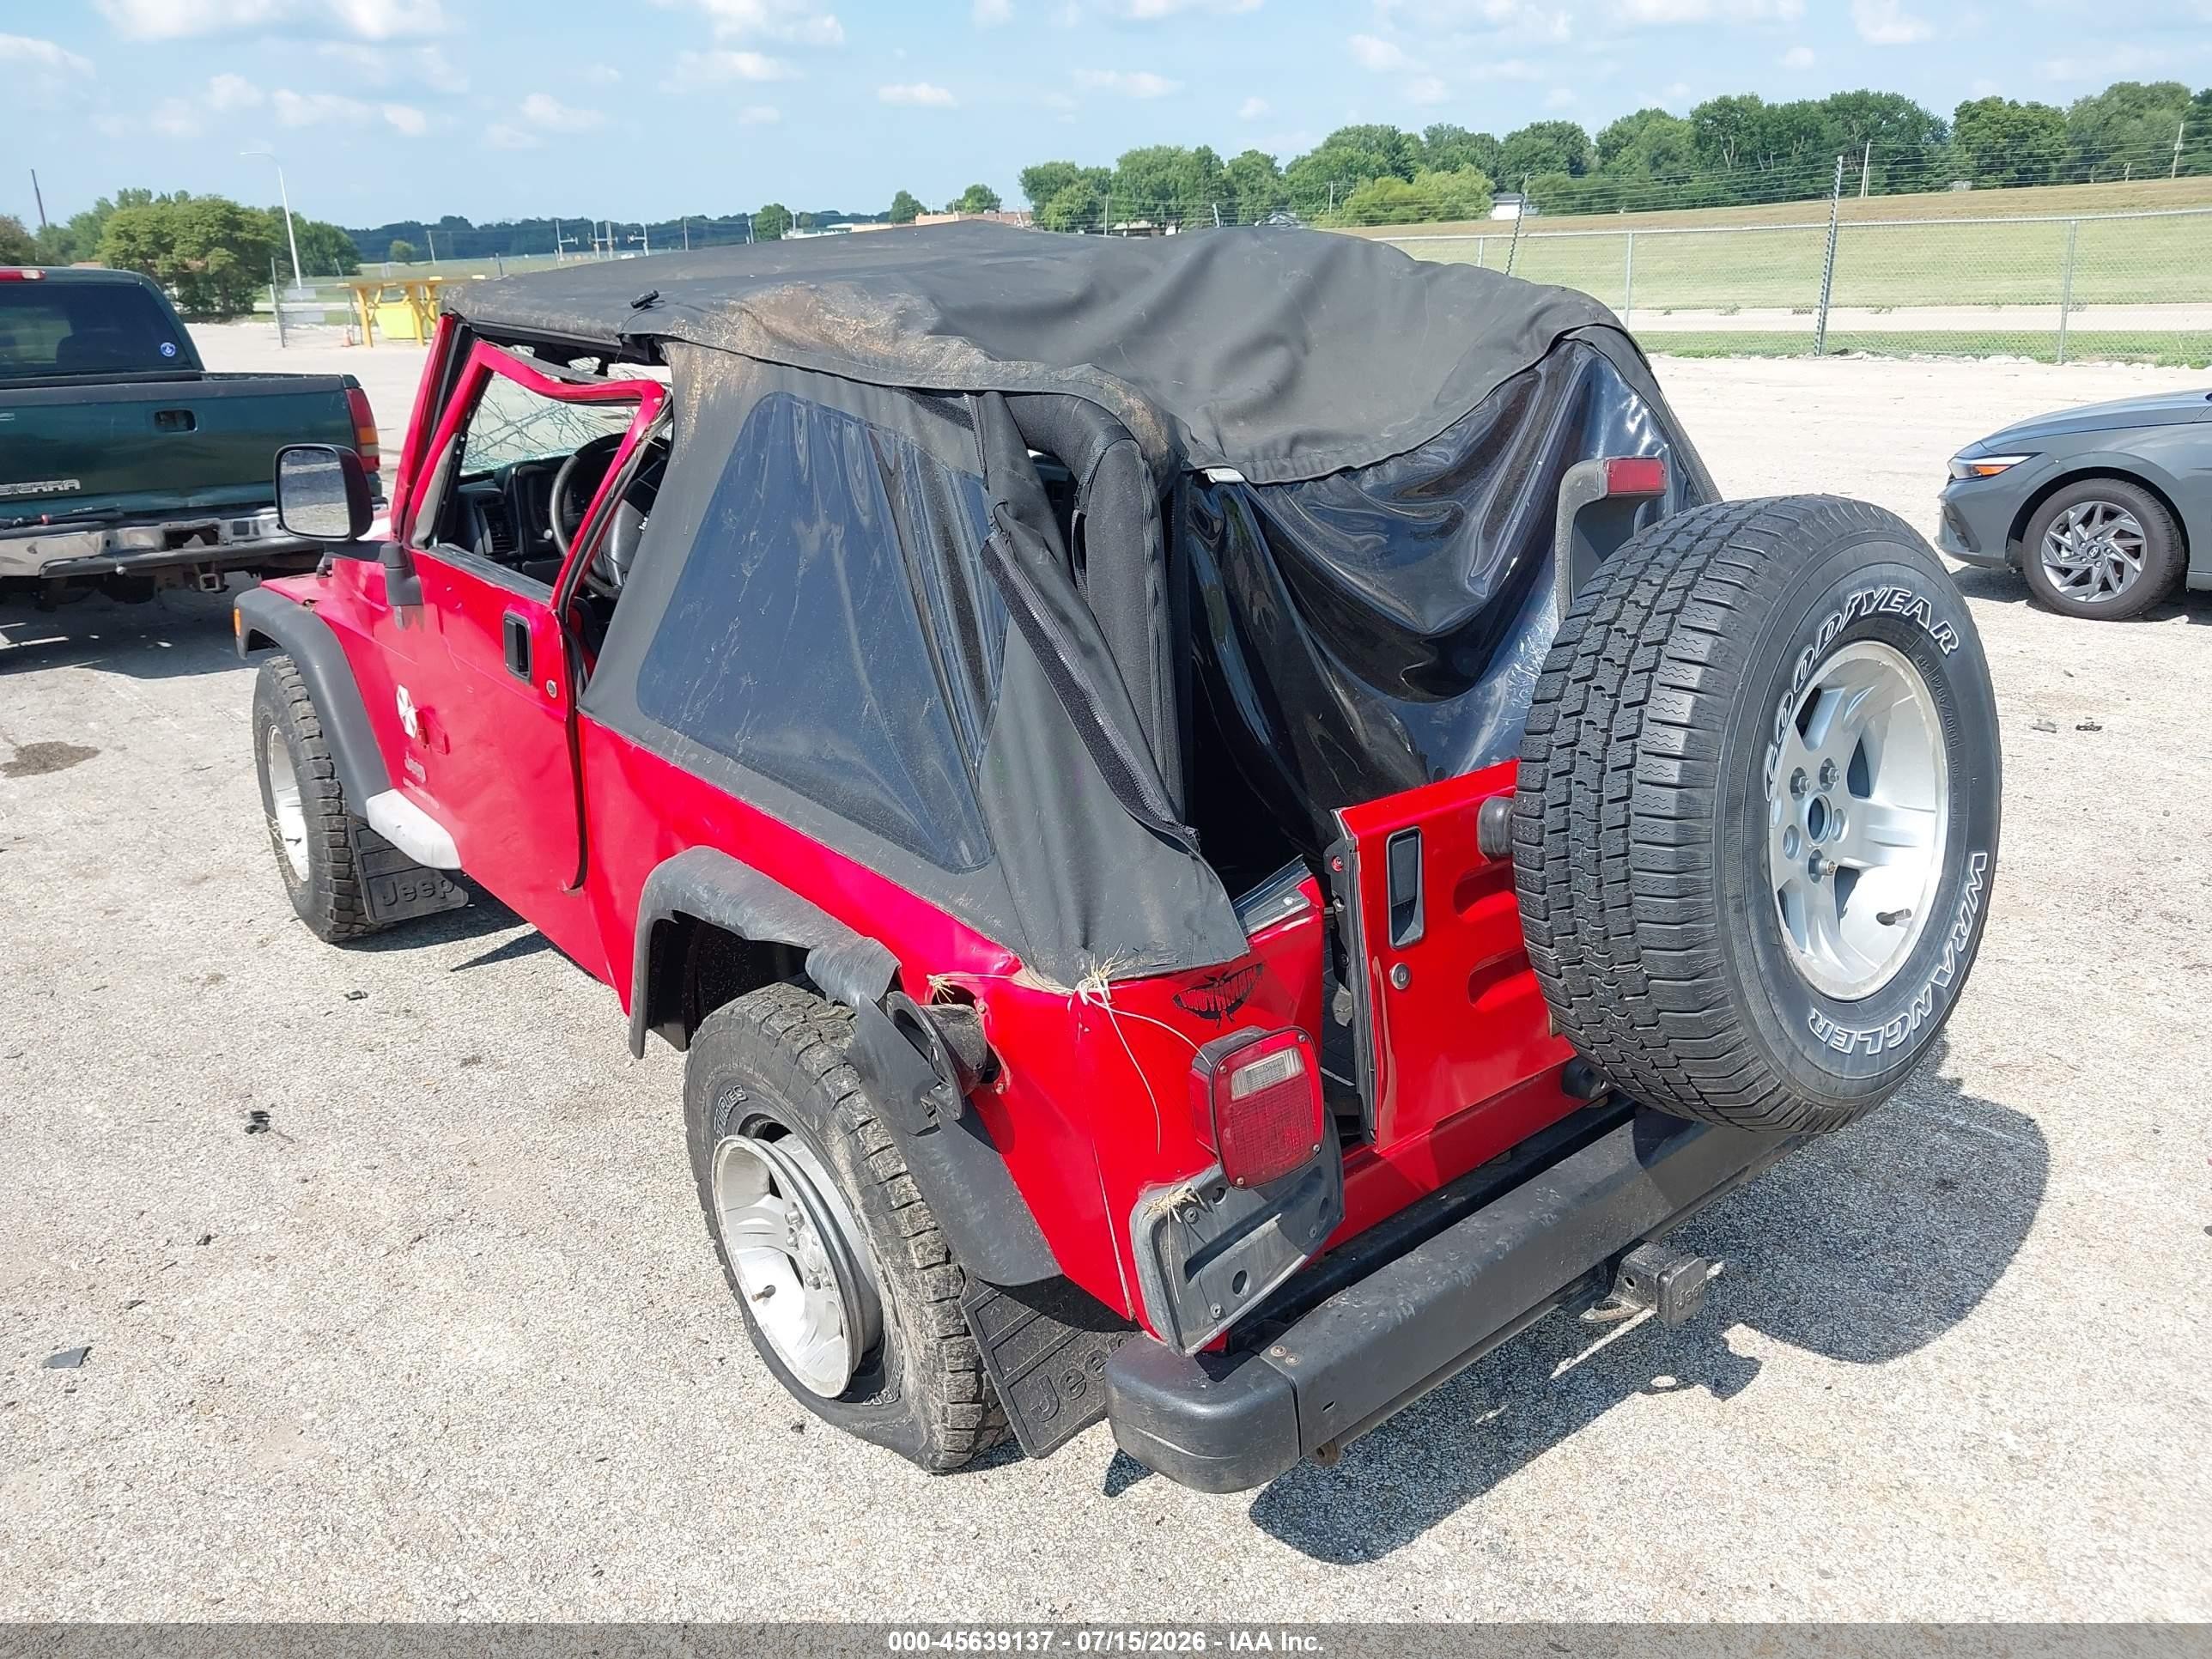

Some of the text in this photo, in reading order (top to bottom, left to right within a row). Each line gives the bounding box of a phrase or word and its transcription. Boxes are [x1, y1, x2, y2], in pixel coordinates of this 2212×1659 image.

[0, 478, 81, 495] SIERRA
[1764, 586, 1960, 802] GOODYEAR
[383, 878, 455, 907] Jeep
[1808, 851, 1989, 1055] WRANGLER
[714, 1085, 749, 1138] TIRES
